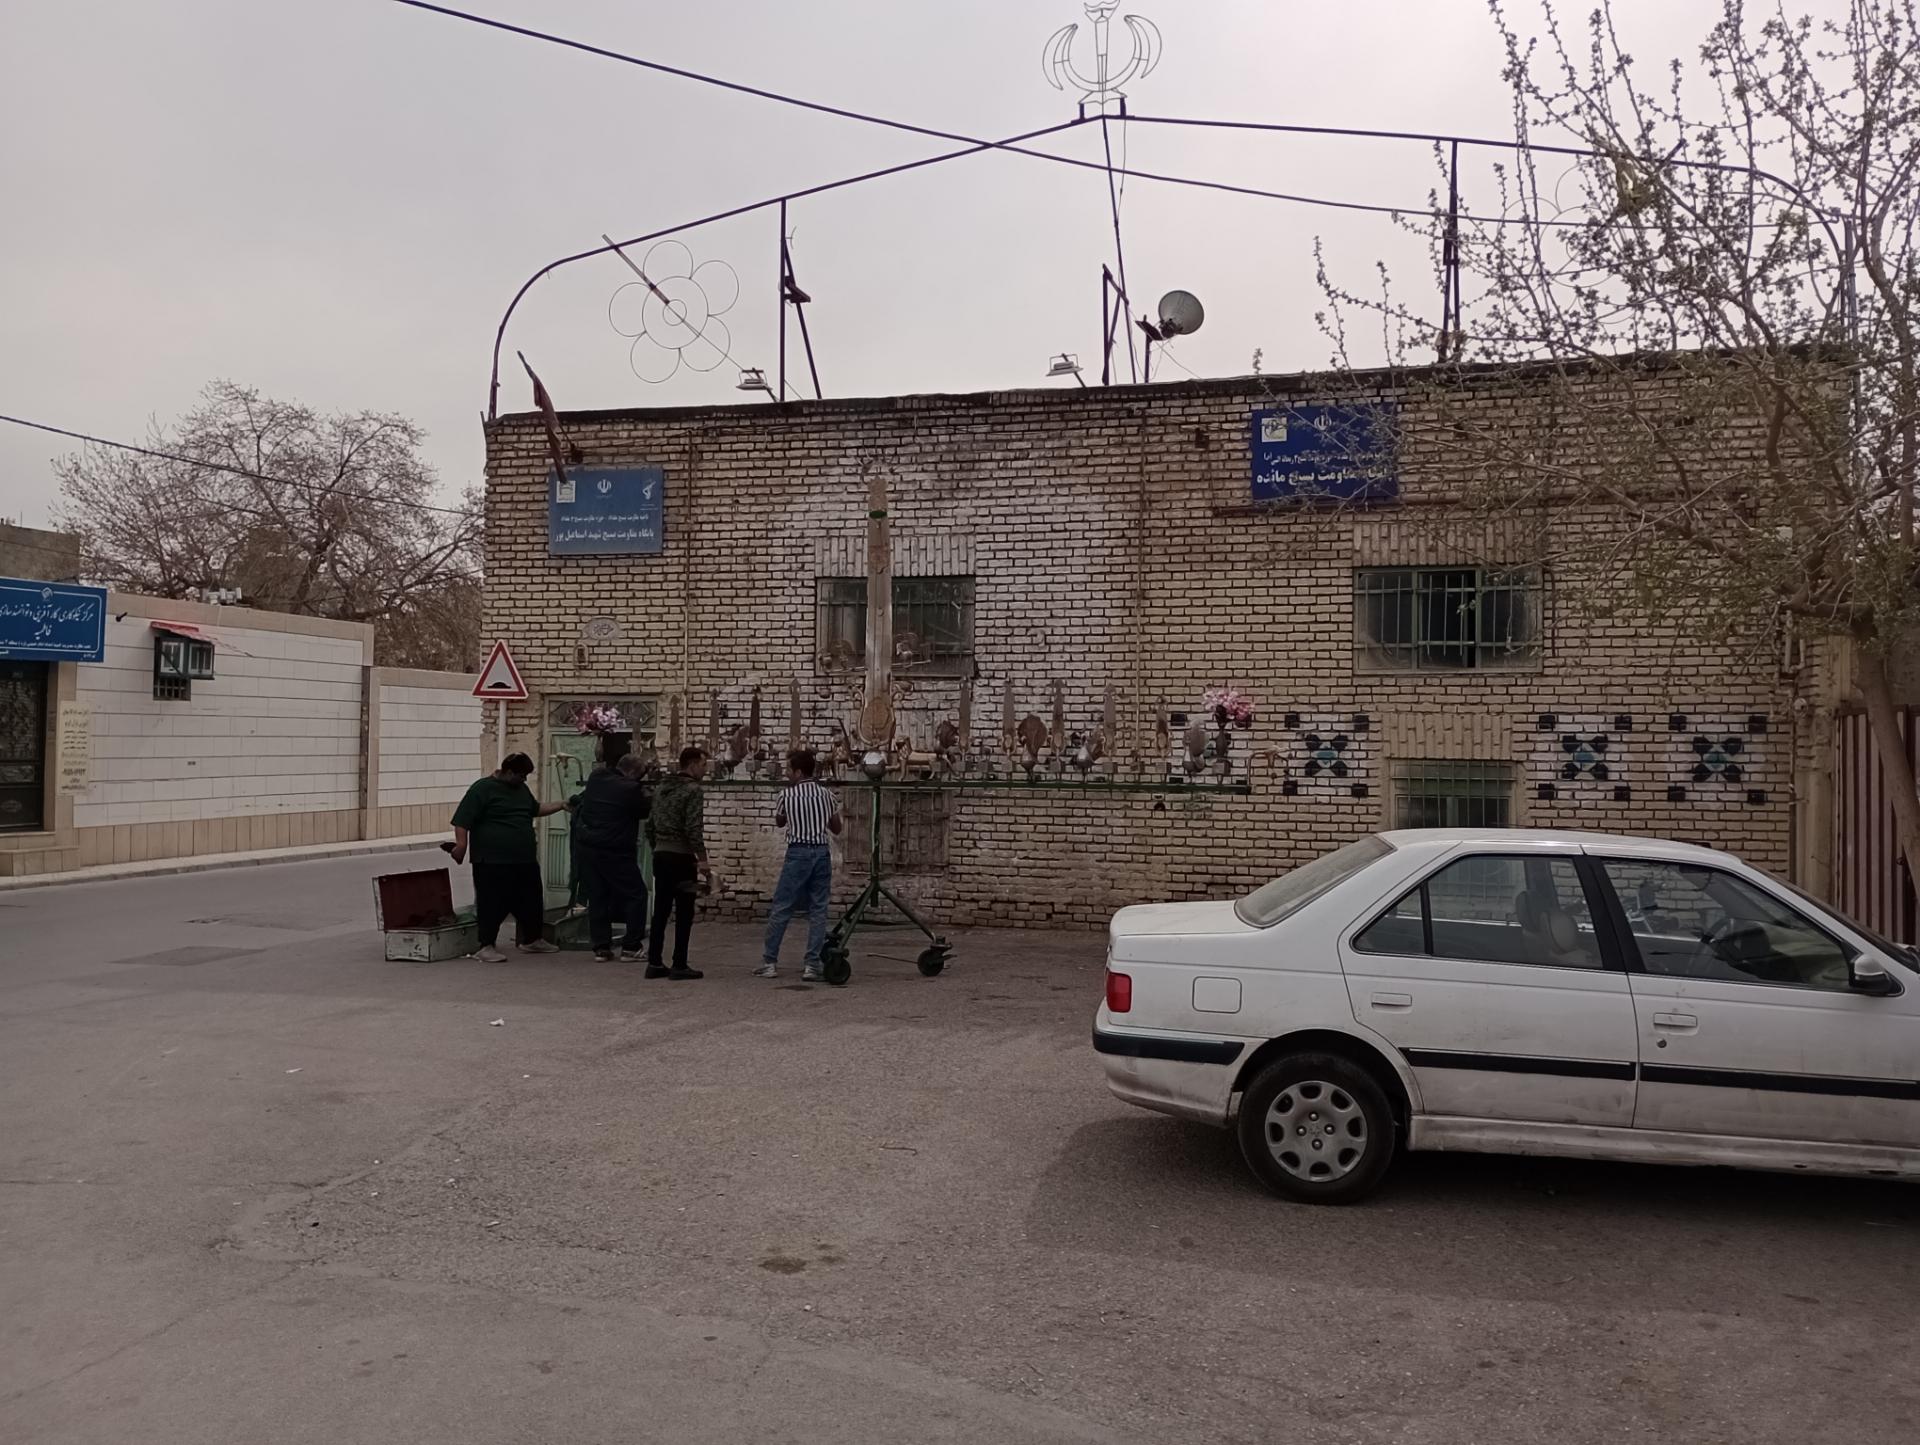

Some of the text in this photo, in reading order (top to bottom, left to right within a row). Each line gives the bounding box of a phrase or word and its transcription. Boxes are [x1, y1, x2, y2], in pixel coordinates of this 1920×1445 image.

[602, 531, 617, 542] بسیج
[617, 528, 638, 541] مقاومت
[638, 527, 654, 541] پایگاه
[58, 602, 86, 623] نیکوکاری
[80, 602, 95, 622] مرکز
